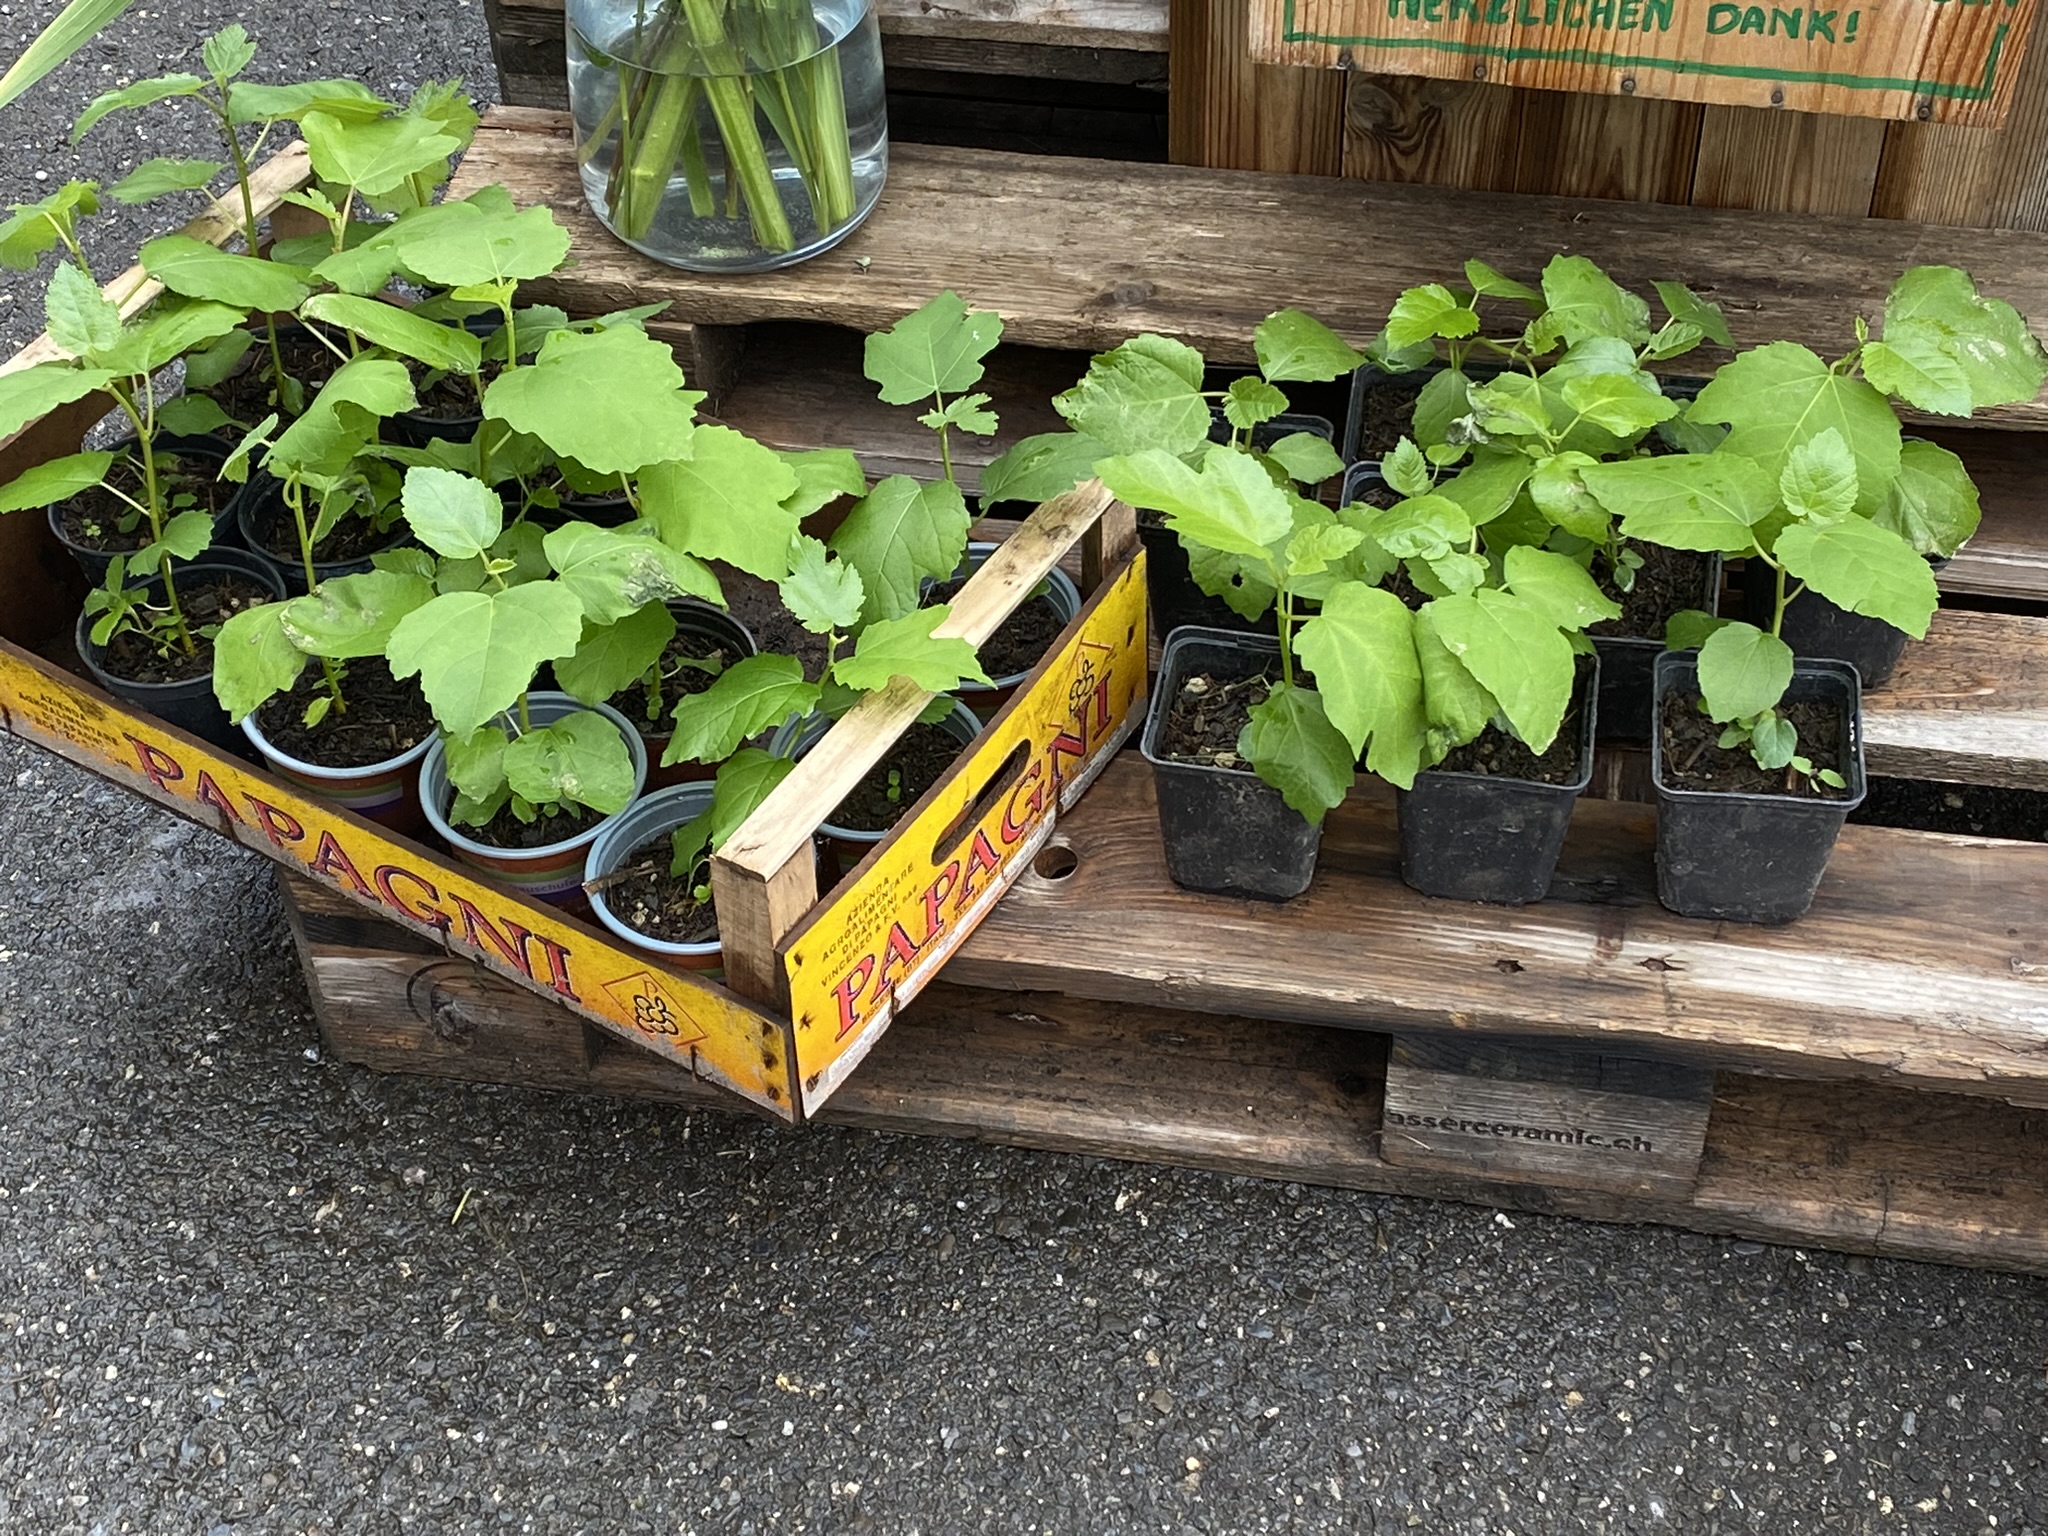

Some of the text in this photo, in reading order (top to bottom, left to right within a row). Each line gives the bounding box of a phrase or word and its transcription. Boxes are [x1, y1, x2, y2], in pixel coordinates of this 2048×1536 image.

[1388, 0, 1861, 43] HERZLICHEN DANK!
[122, 731, 582, 1003] PAPAGNI
[831, 668, 1113, 1042] PAPAGNI
[821, 862, 914, 963] AGROALIMENTARE
[846, 877, 889, 926] AZIENDA
[854, 893, 897, 941] PAPAGNI
[820, 934, 873, 988] VINCENZO
